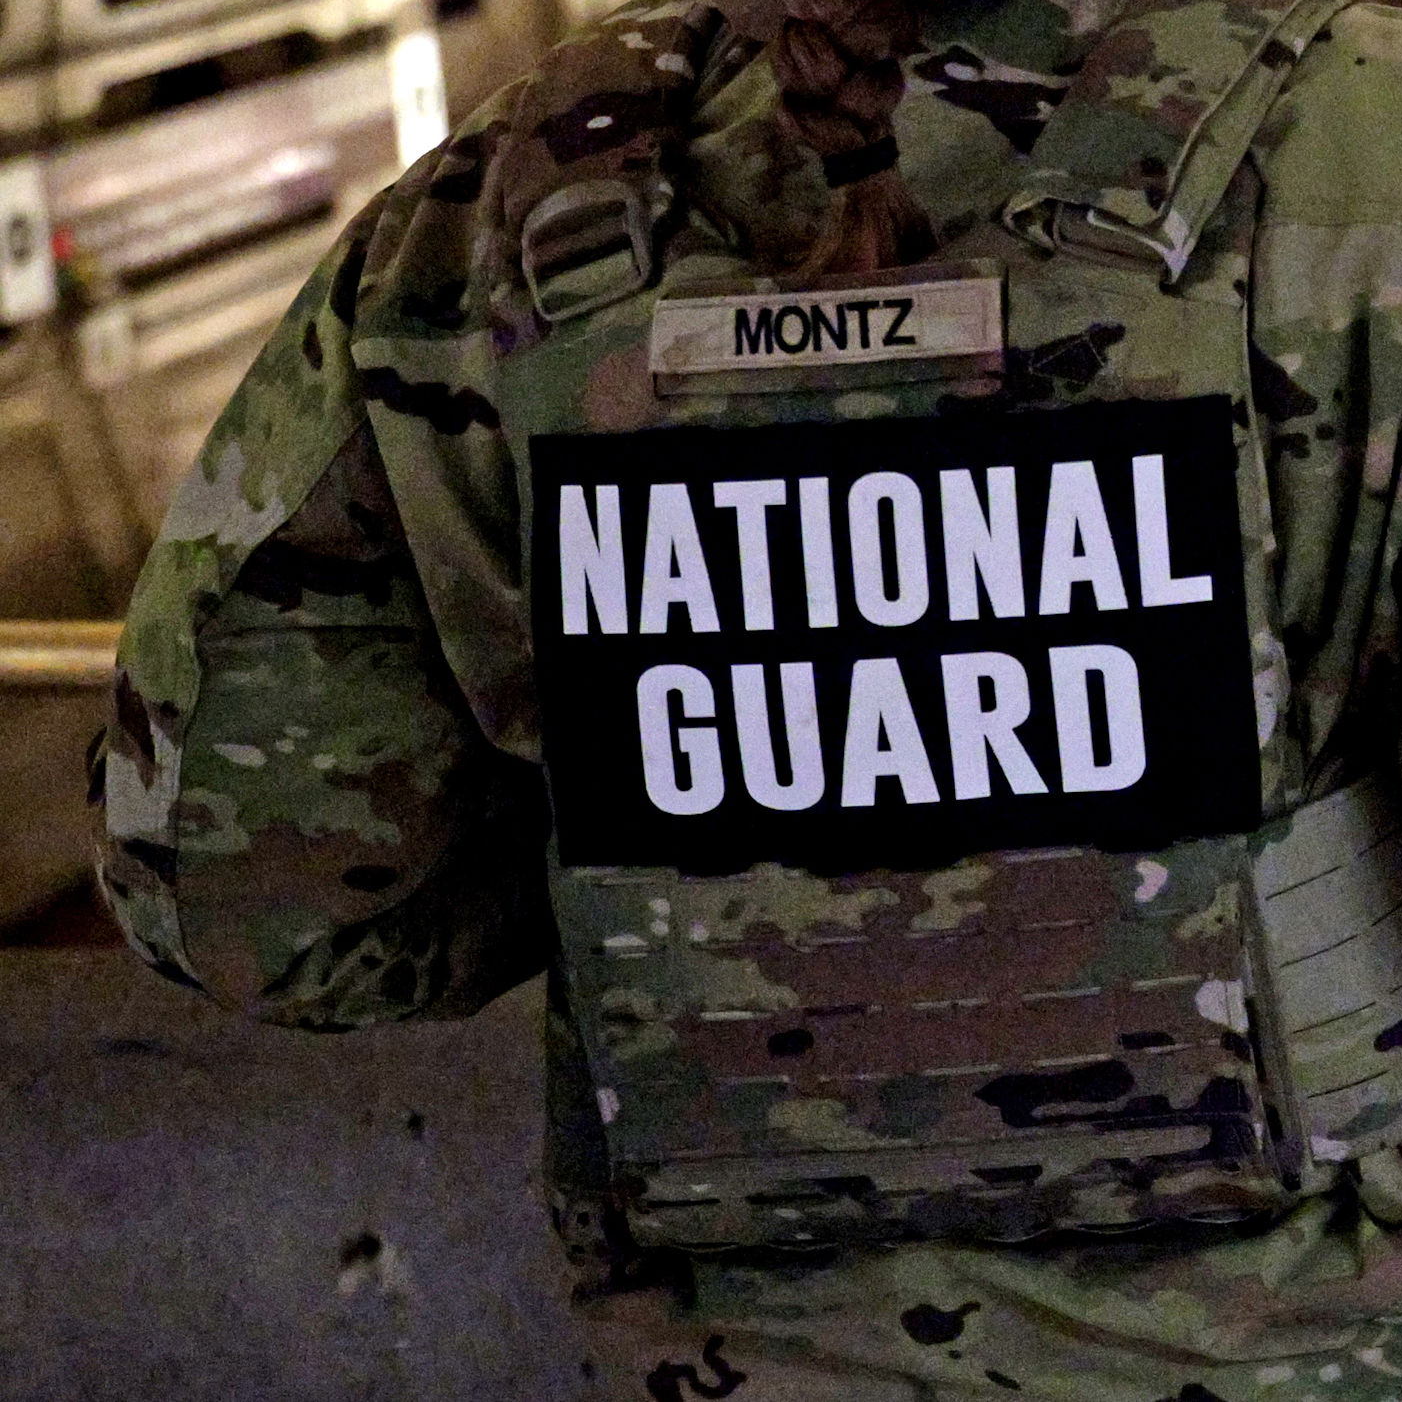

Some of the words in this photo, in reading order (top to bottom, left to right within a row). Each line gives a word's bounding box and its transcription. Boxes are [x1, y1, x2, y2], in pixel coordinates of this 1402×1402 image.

[734, 298, 916, 356] MONTZ
[560, 454, 1213, 634] NATIONAL
[637, 644, 1146, 815] GUARD
